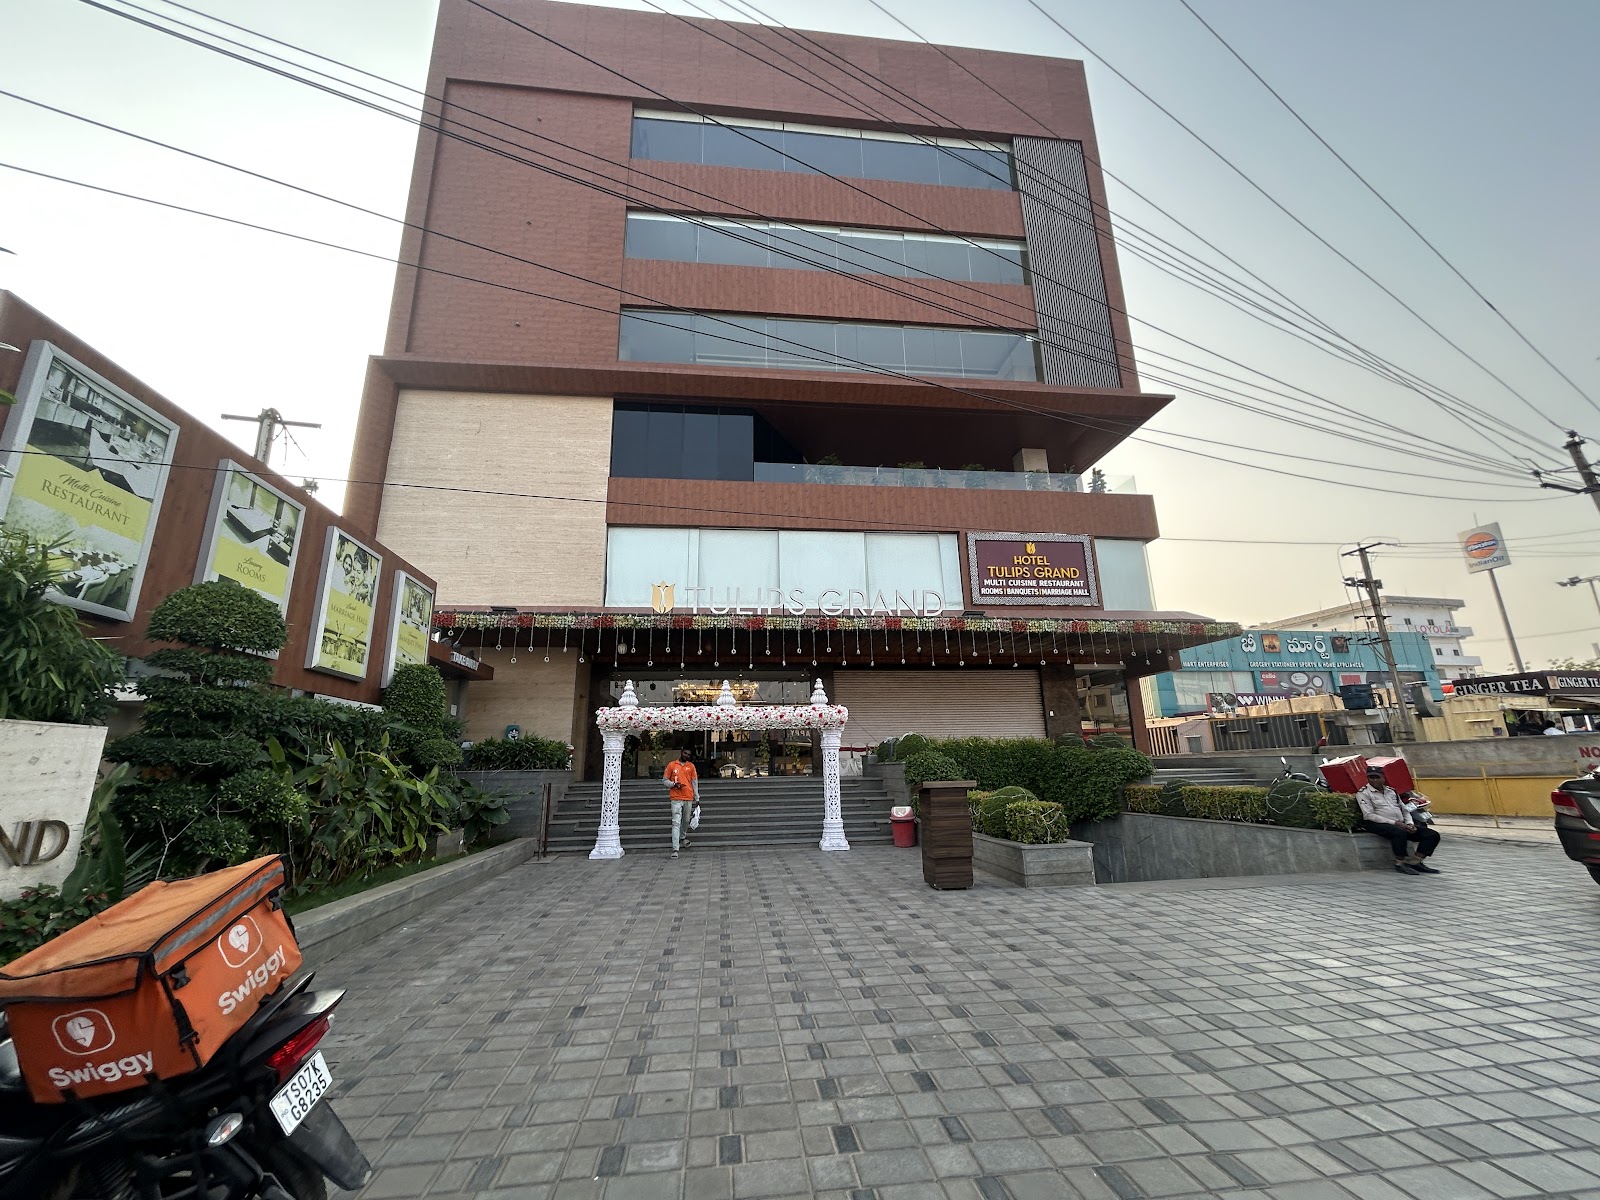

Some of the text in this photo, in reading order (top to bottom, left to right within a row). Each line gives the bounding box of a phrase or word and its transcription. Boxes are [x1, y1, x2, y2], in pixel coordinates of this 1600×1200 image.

[59, 473, 121, 507] Multi Cuisine
[41, 478, 131, 525] RESTAURANT
[1013, 555, 1051, 566] HOTEL
[1468, 555, 1505, 568] IndianOil
[236, 562, 267, 583] ROOMS
[983, 578, 1085, 587] MULTI CUISINE RESTAURANT
[987, 565, 1080, 579] TULIPS GRAND
[685, 586, 945, 618] TULIPS GRAND
[1006, 588, 1039, 596] BANQUETS
[1073, 588, 1090, 596] HALL
[1413, 624, 1452, 635] LOYOLA
[1286, 635, 1330, 660] మార్ట్
[1454, 678, 1544, 697] GINGER TEA
[1557, 676, 1600, 688] GINGER TE
[217, 944, 286, 1016] Swiggy
[48, 1050, 154, 1088] Swiggy
[281, 1059, 321, 1105] TS07K
[290, 1073, 327, 1121] G8235
